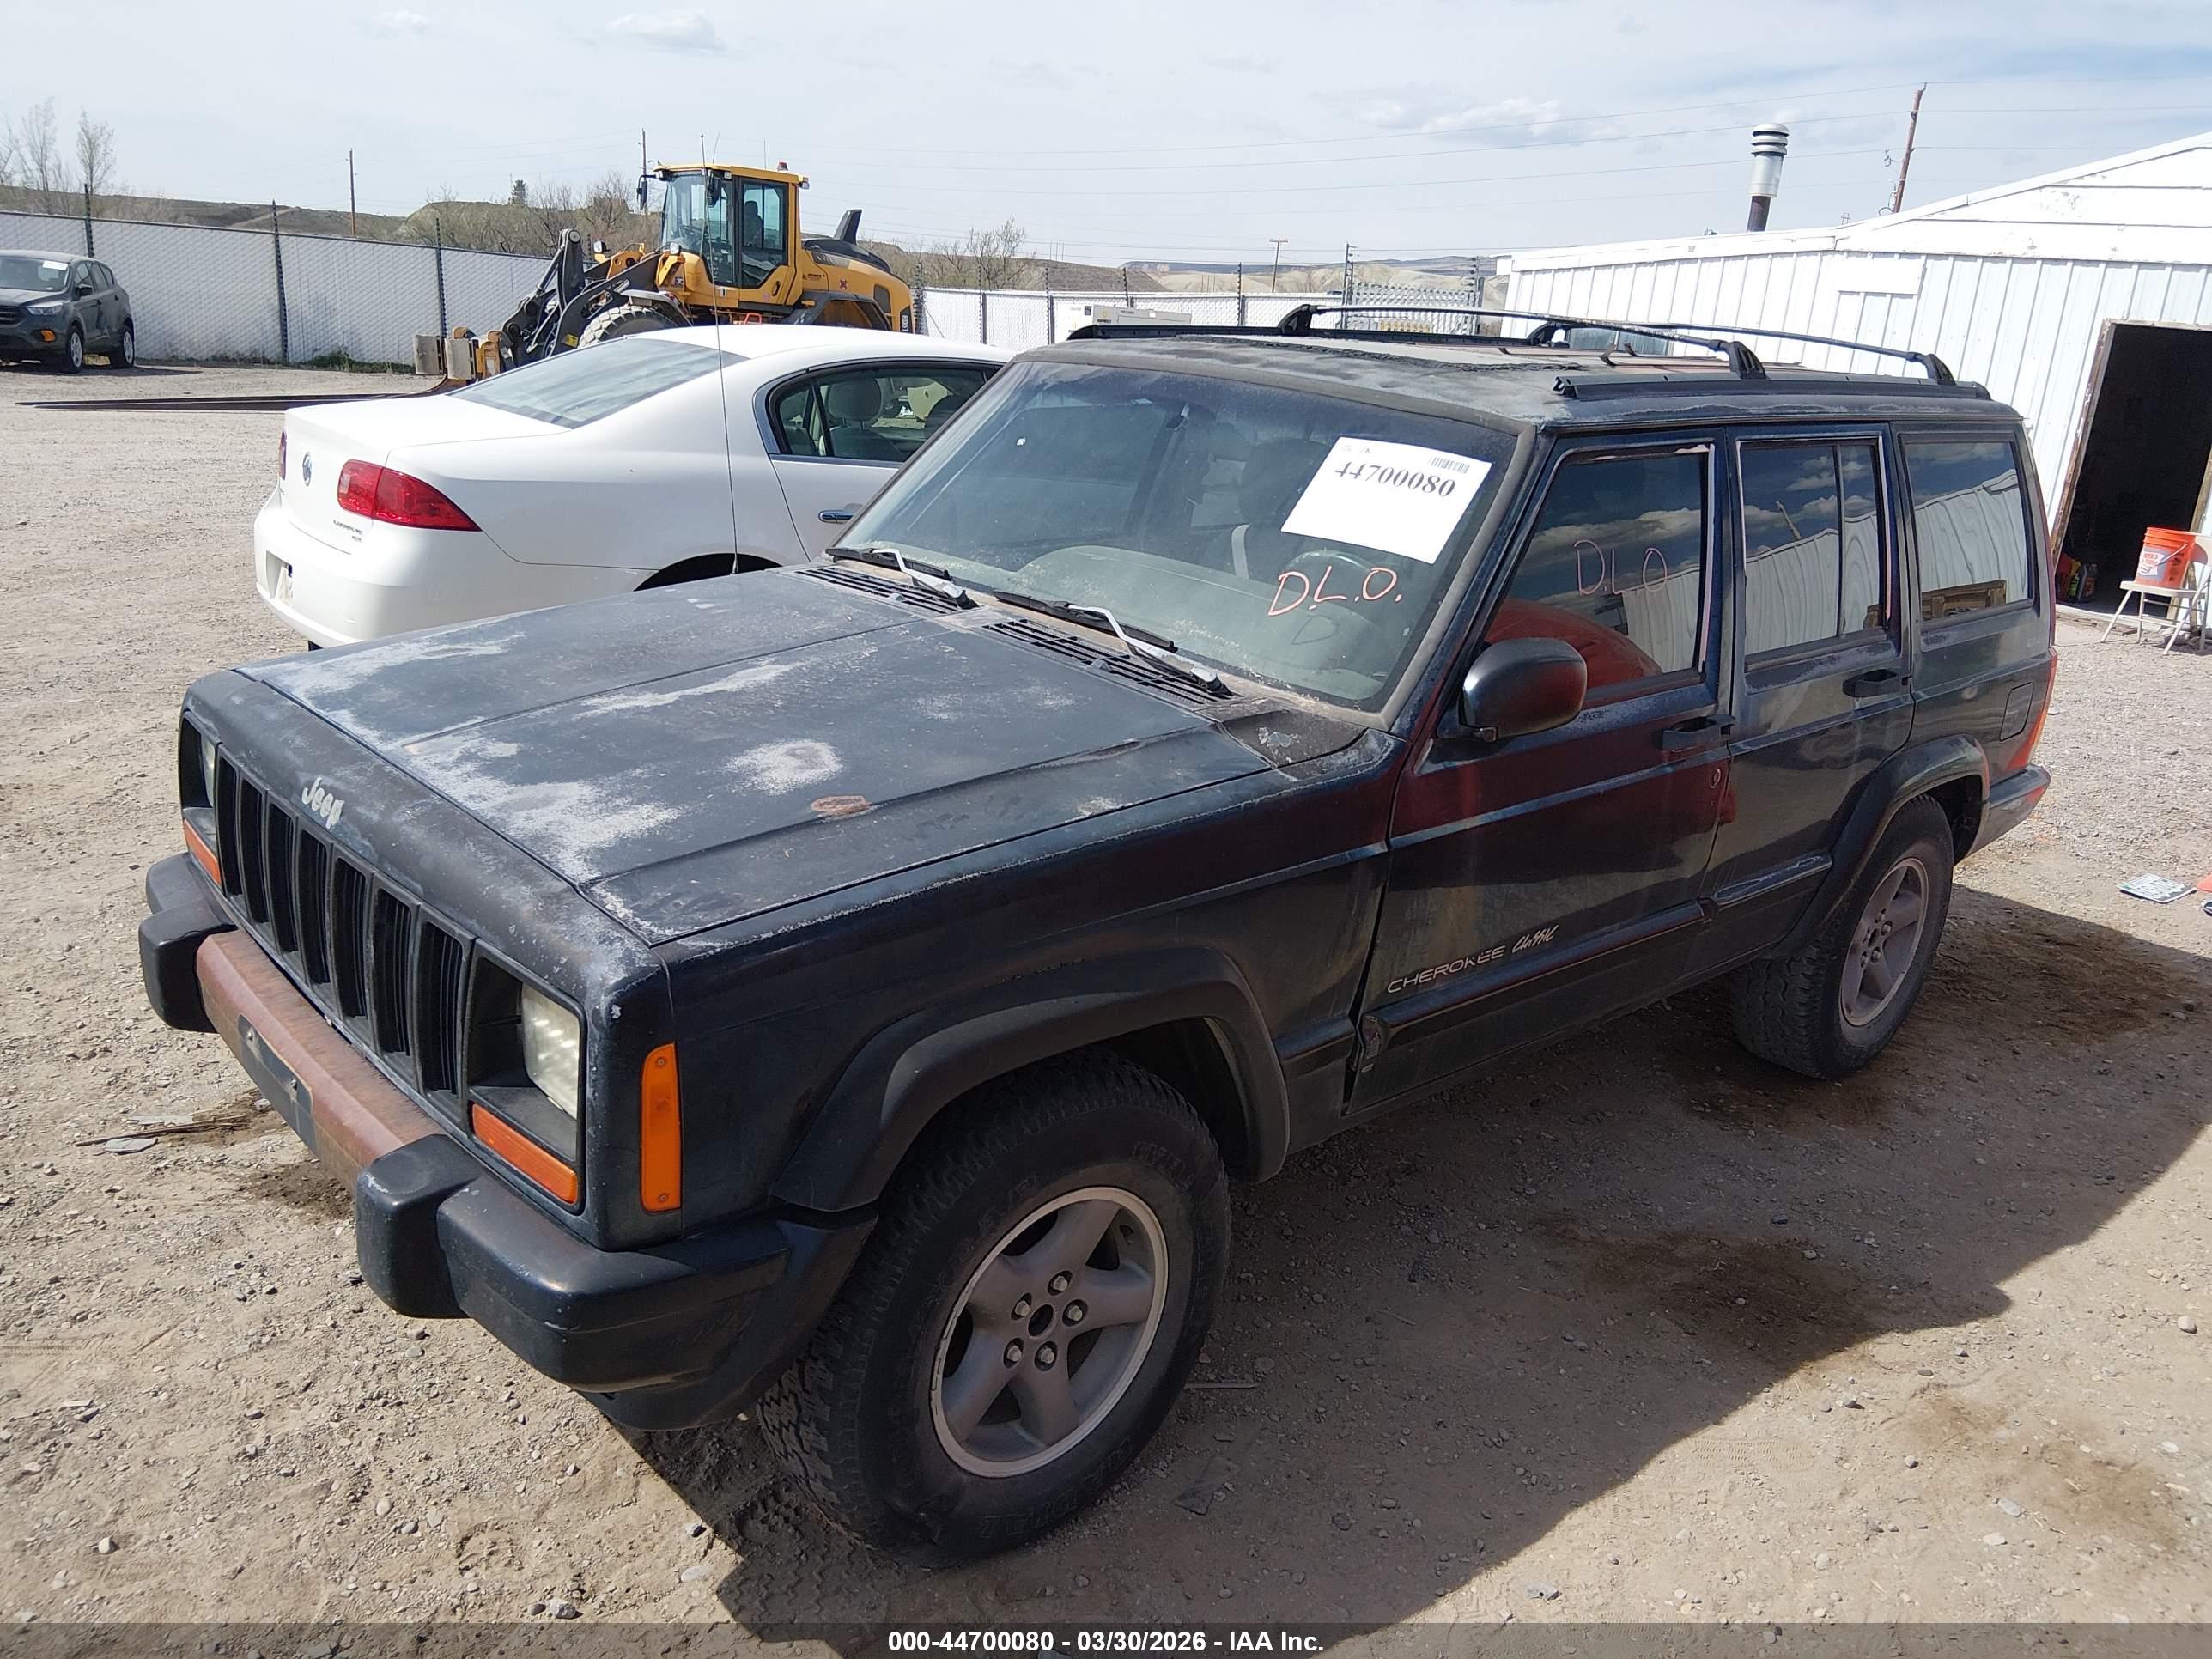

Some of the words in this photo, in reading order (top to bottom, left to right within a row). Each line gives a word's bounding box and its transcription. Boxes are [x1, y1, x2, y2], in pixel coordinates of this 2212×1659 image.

[1334, 461, 1456, 497] 44700080
[301, 776, 345, 830] Jeep
[1387, 945, 1506, 994] CHEROKEE
